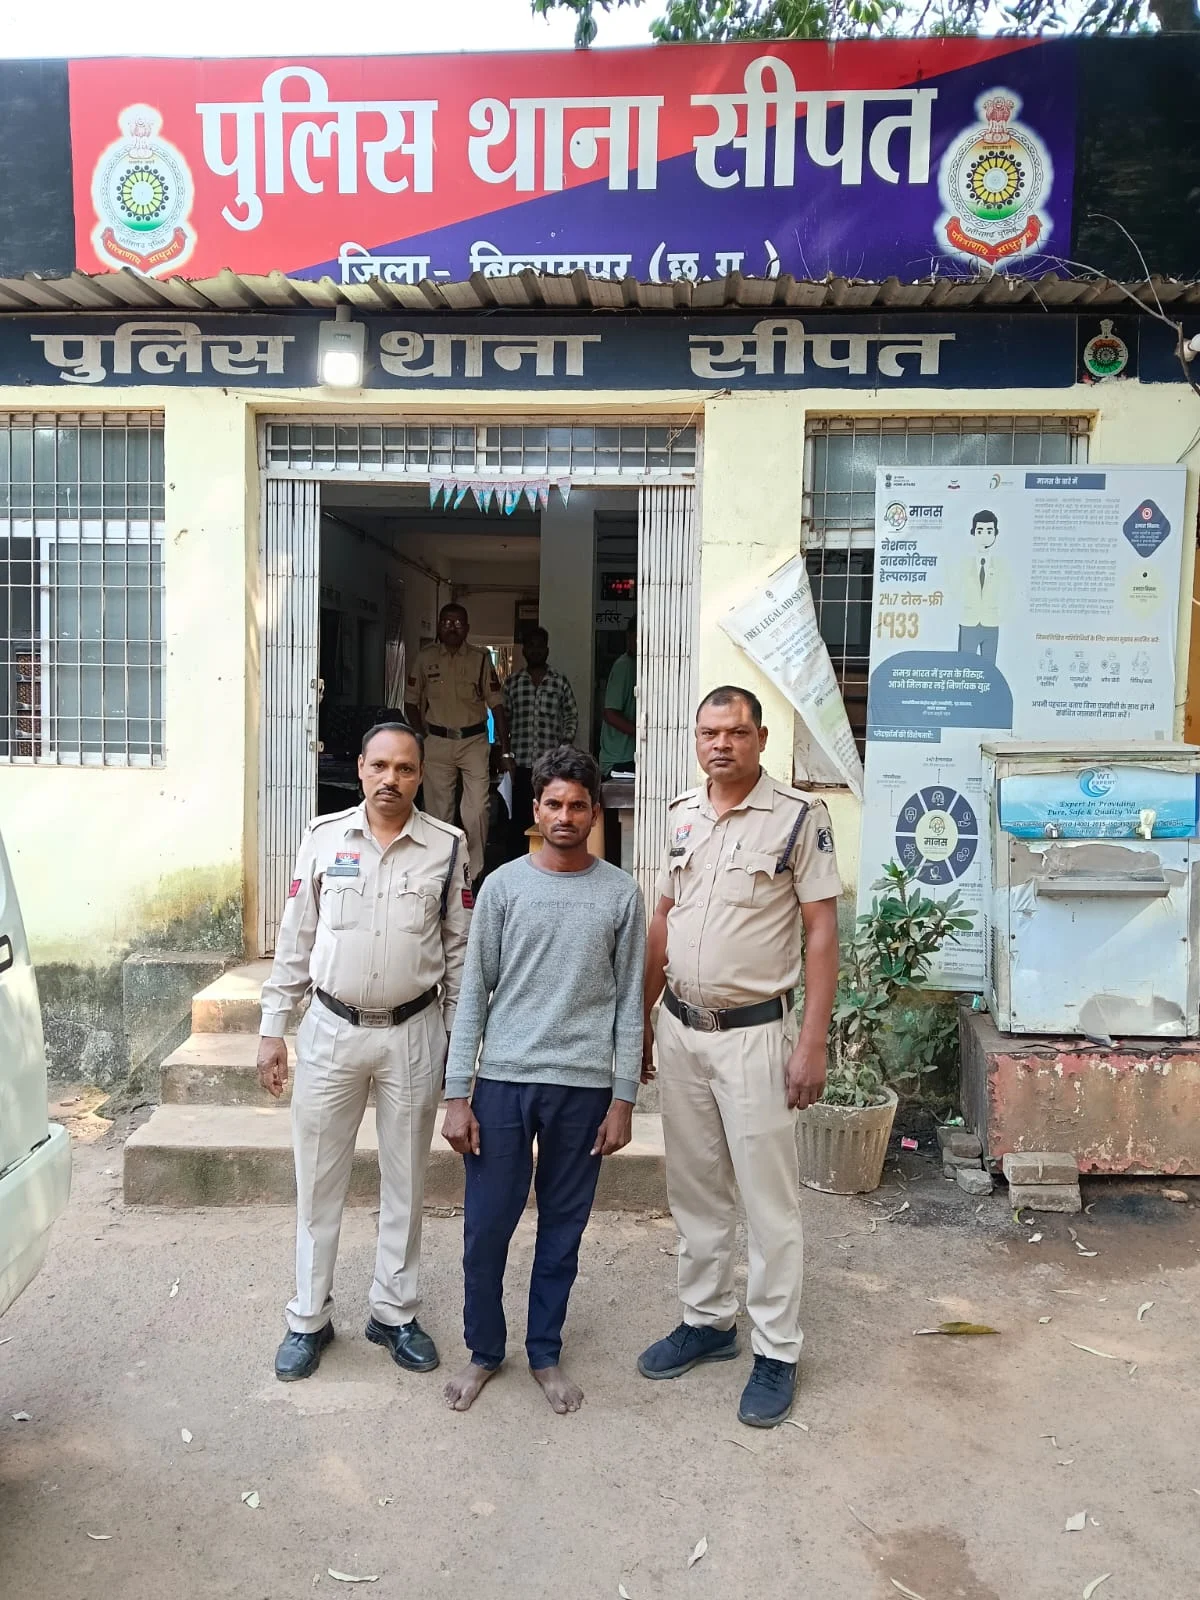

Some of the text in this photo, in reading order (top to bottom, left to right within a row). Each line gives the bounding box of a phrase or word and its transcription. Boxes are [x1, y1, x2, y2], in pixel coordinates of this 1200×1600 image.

[196, 55, 938, 231] पुलिस थाना सीपत
[31, 318, 956, 384] पुलिस थाना सीपत
[909, 505, 944, 517] मानस
[881, 537, 918, 551] नेशनल
[880, 553, 938, 567] नारकोटिक्स
[879, 568, 928, 583] हेल्पलाइन
[743, 625, 763, 642] FREE
[759, 607, 783, 629] LEGAL
[781, 597, 795, 611] AID
[876, 612, 919, 638] 1933
[911, 668, 930, 678] भारत
[930, 668, 939, 678] में
[953, 668, 962, 678] के
[888, 679, 905, 689] आओ
[906, 679, 933, 690] मिलकर
[946, 680, 977, 691] निर्णायक
[1060, 802, 1085, 810] Expert
[1099, 801, 1136, 809] Providing
[1069, 808, 1085, 817] Safe
[1094, 808, 1123, 817] Quality
[923, 837, 948, 847] मानस
